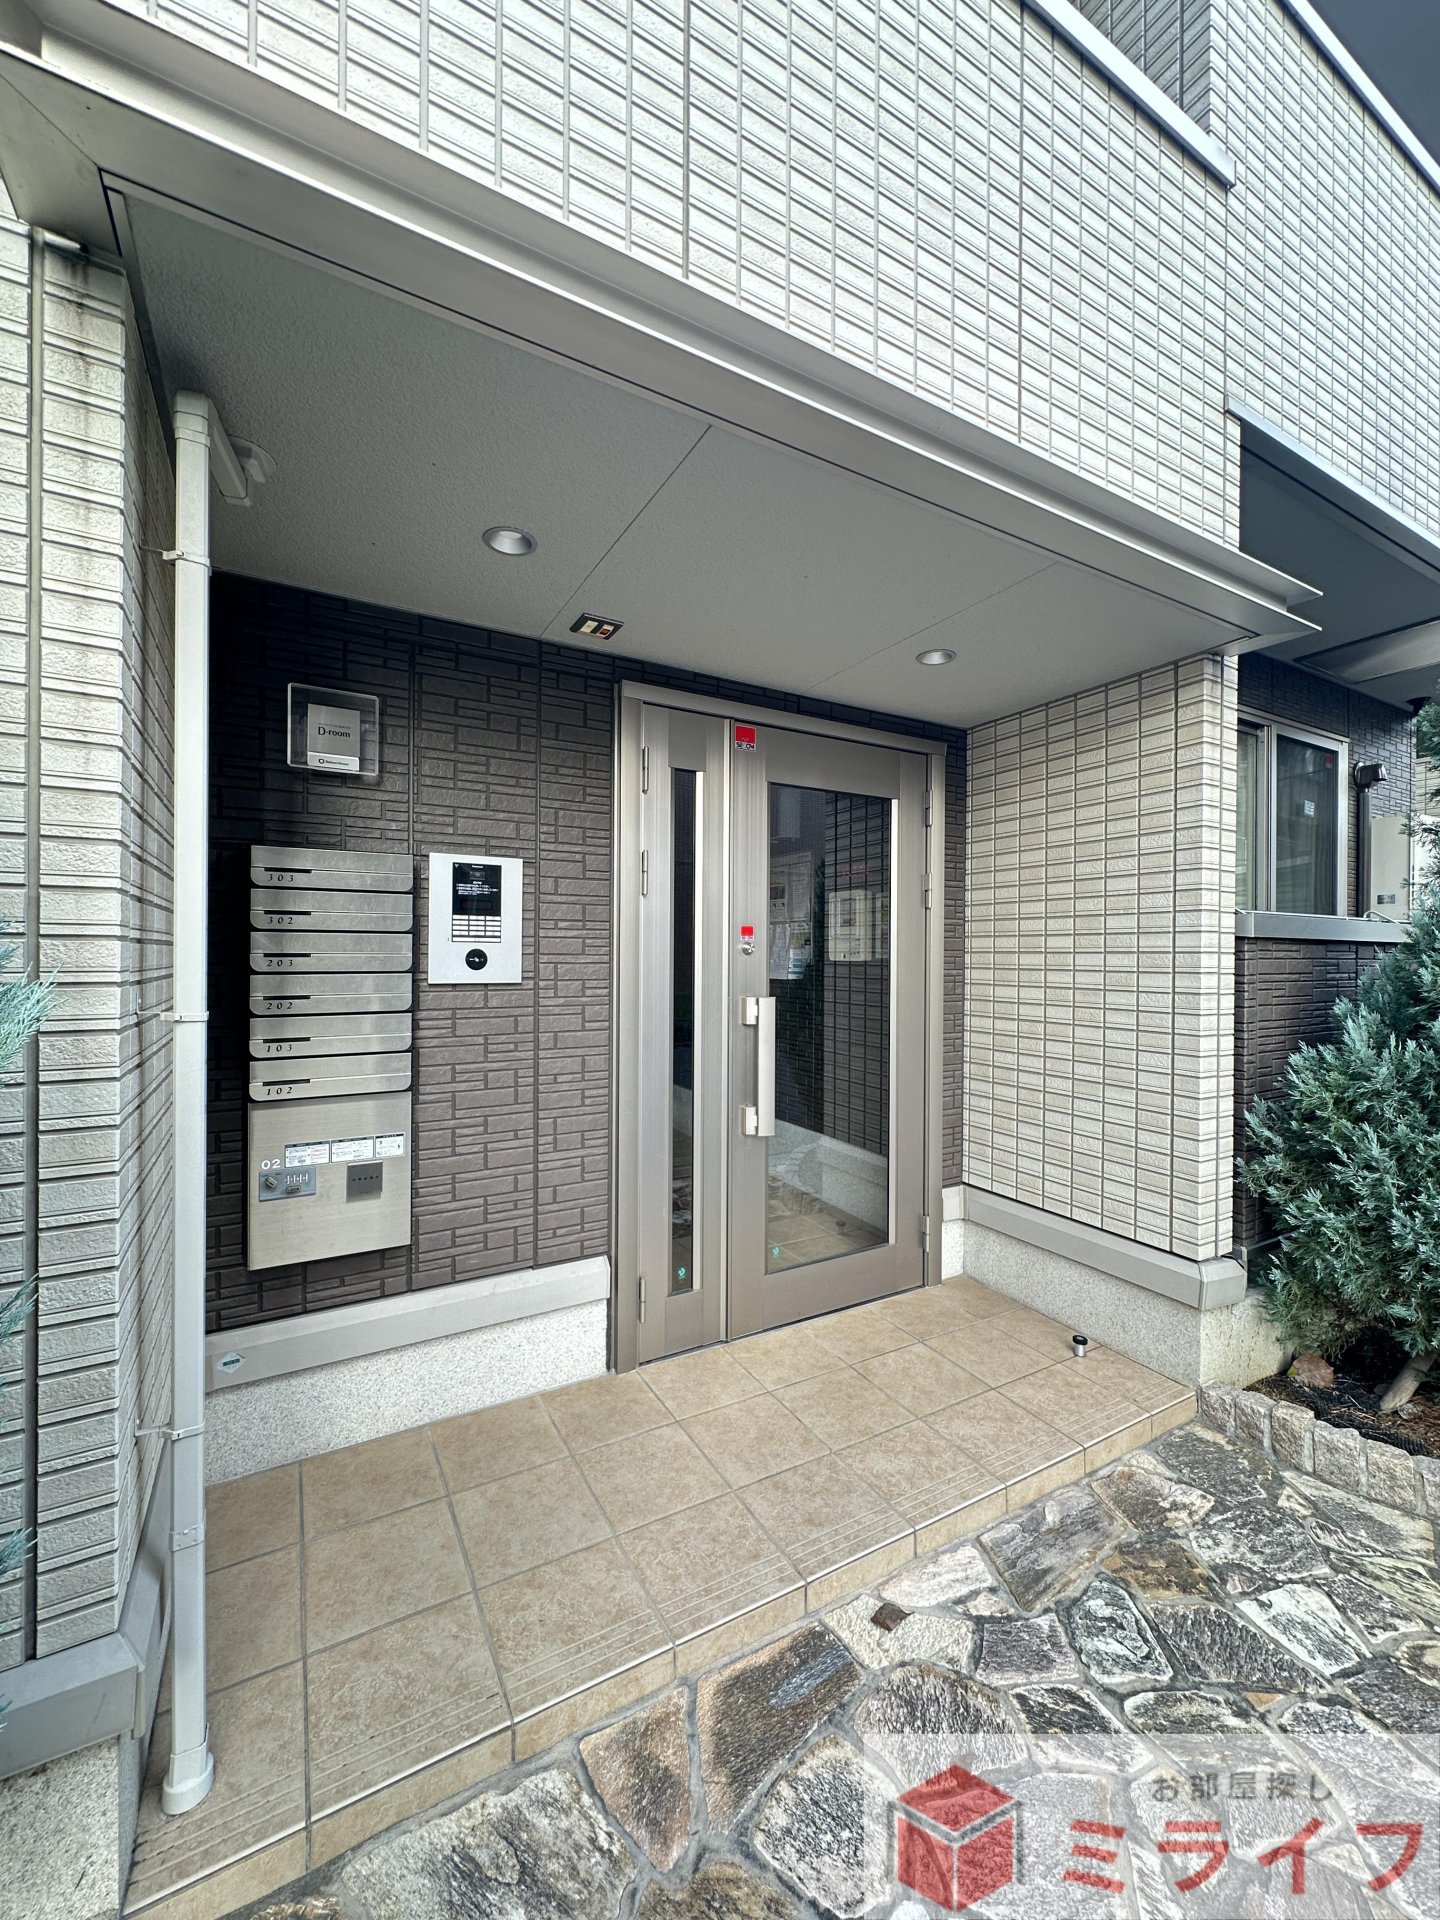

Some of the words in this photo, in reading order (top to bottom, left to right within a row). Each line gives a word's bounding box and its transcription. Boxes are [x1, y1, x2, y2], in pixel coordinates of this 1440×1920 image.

[318, 726, 351, 738] D-room
[267, 873, 294, 882] 303
[267, 916, 294, 924] 302
[266, 959, 293, 967] 203
[266, 1001, 293, 1010] 202
[266, 1044, 293, 1053] 103
[266, 1086, 293, 1096] 102
[261, 1158, 281, 1170] 02
